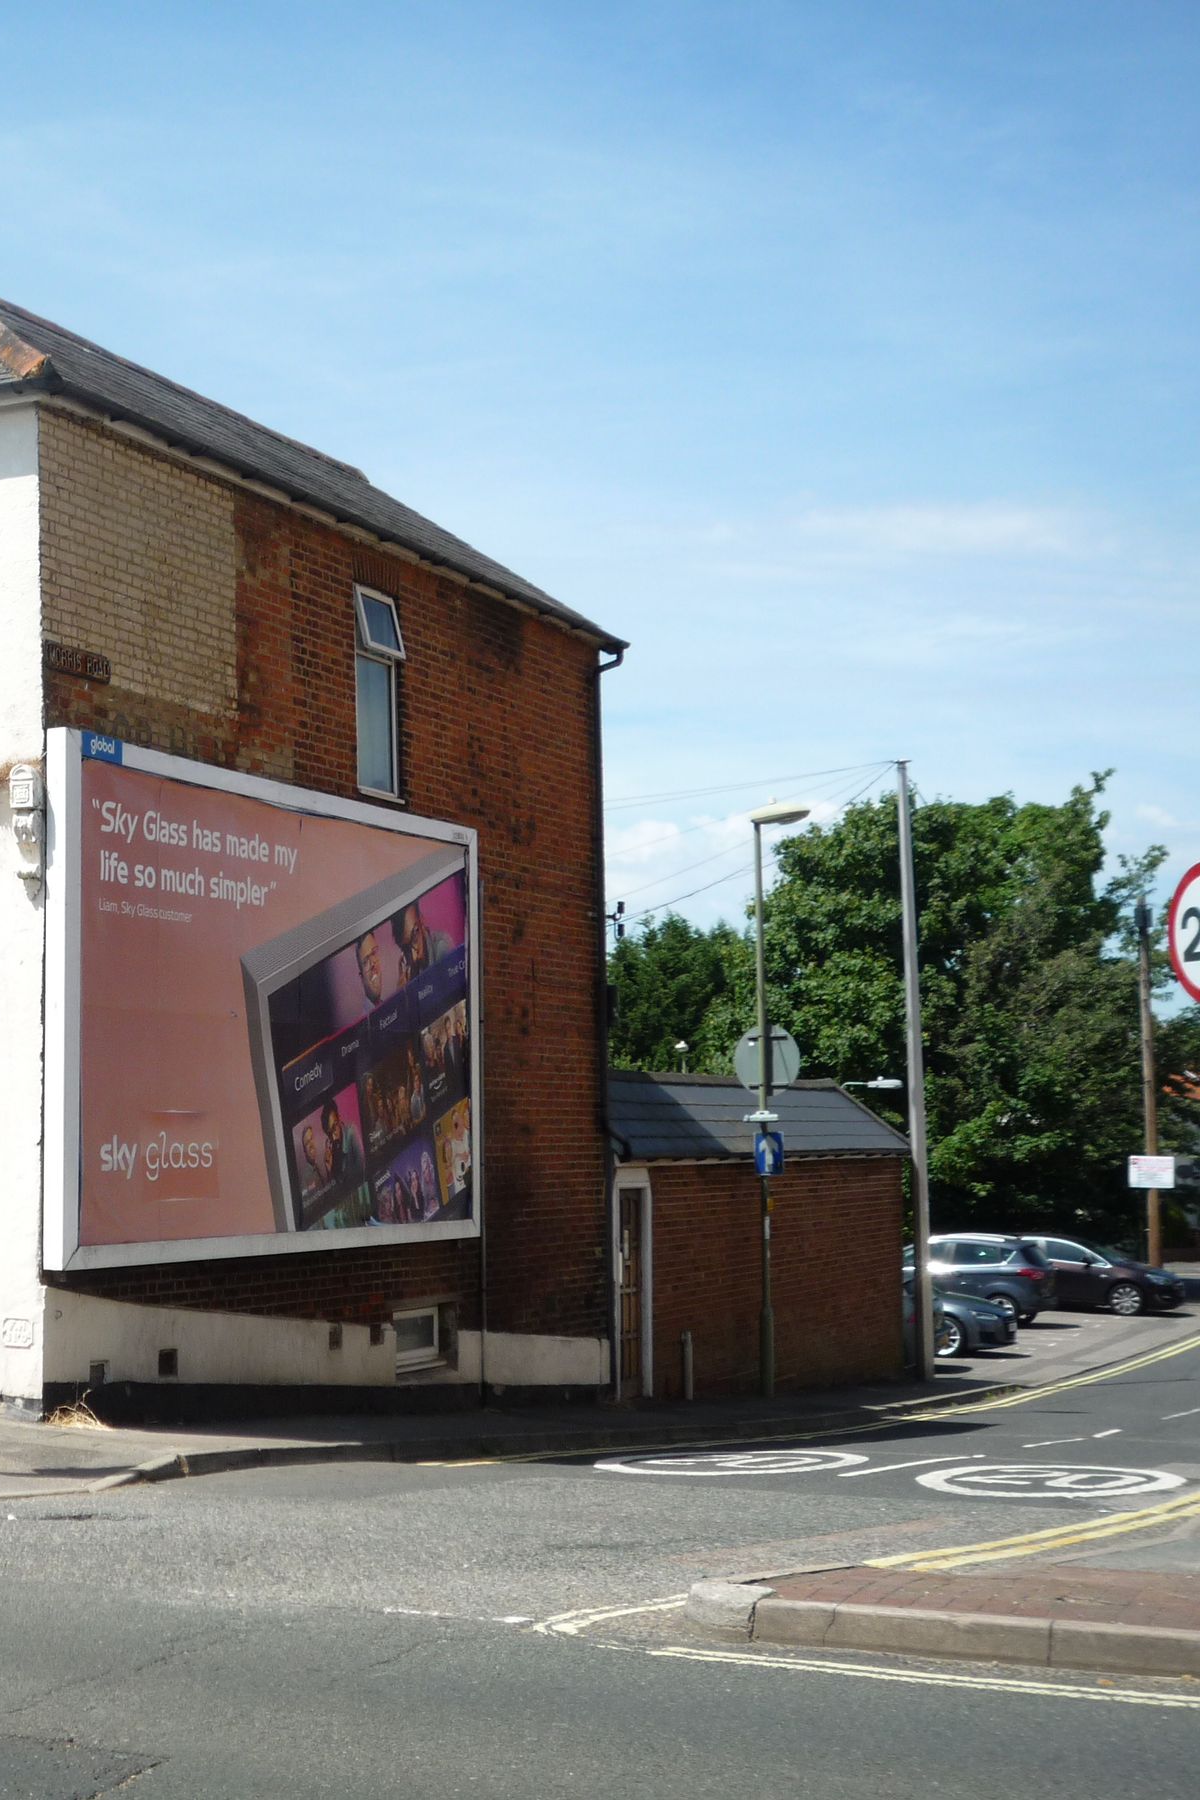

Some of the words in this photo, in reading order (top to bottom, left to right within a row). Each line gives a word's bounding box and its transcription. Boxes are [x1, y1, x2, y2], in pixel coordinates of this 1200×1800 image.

[47, 644, 82, 672] MORRIS
[86, 657, 111, 680] ROAD
[90, 736, 115, 755] global
[143, 810, 188, 847] Glass
[192, 820, 221, 853] has
[226, 834, 269, 862] made
[274, 845, 298, 875] my
[100, 850, 129, 885] life
[134, 864, 156, 889] so
[161, 867, 205, 897] much
[99, 897, 120, 914] Liam,
[121, 900, 135, 917] Sky
[136, 904, 159, 919] Glass
[159, 909, 193, 923] customer
[1181, 906, 1200, 962] 2
[379, 1009, 398, 1031] Factual
[341, 1039, 360, 1057] Drama
[294, 1062, 323, 1092] Comedy
[100, 1134, 138, 1180] sky
[146, 1131, 213, 1181] glass
[954, 1470, 1144, 1488] 20
